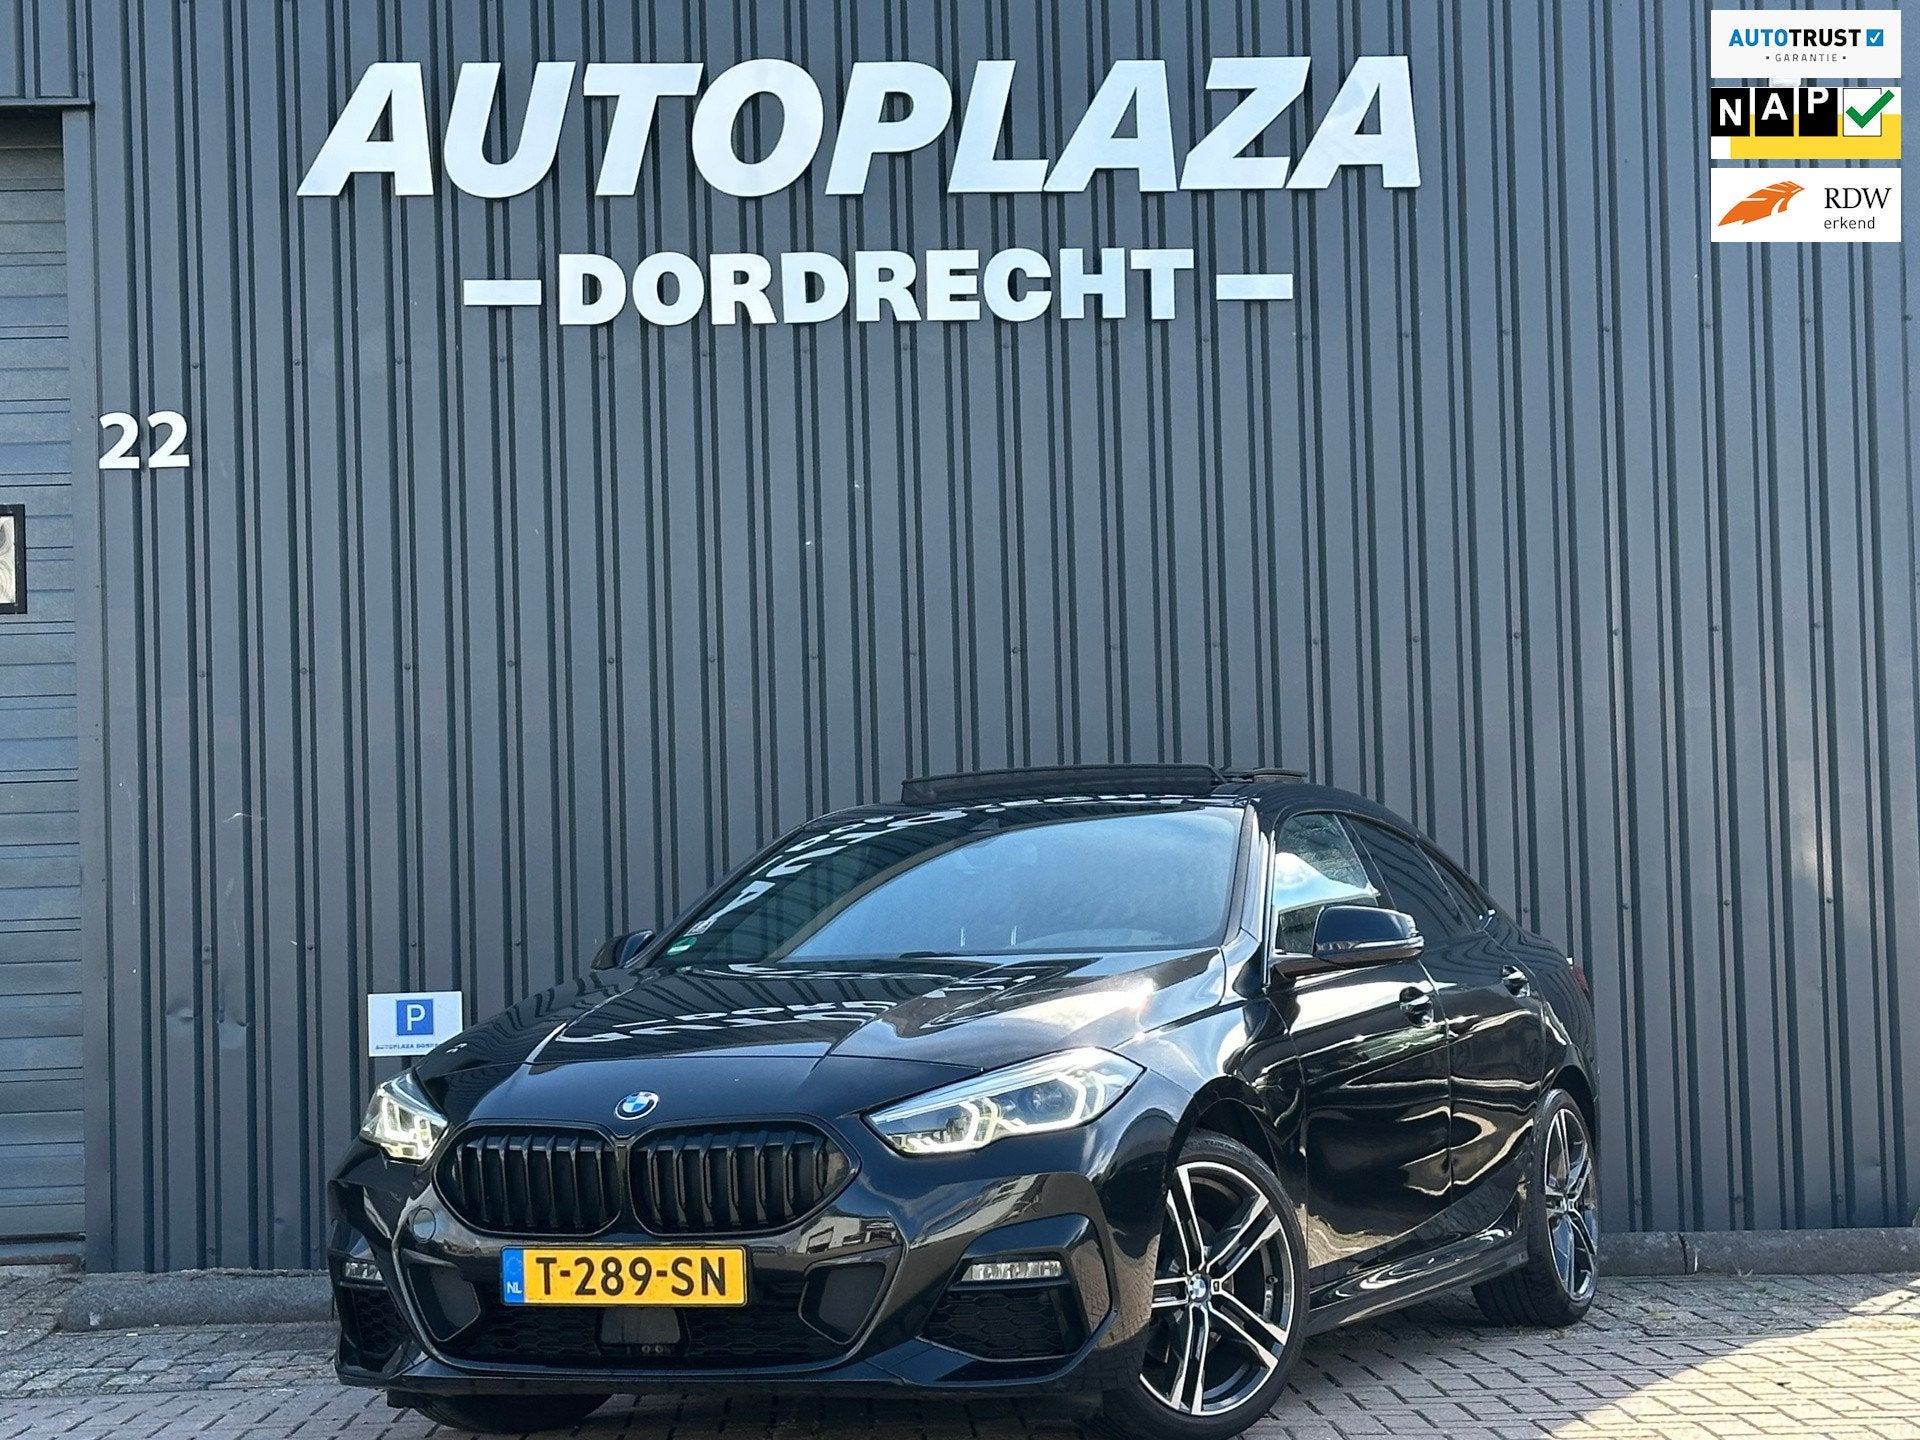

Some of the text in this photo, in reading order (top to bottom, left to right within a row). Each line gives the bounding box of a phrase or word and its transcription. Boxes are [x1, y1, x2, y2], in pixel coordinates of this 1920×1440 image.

[297, 55, 1421, 198] AUTOPLAZA
[559, 248, 1194, 325] DORDRECHT
[99, 410, 190, 470] 22
[406, 1003, 426, 1031] P
[506, 1256, 726, 1297] NL T-289-SN
